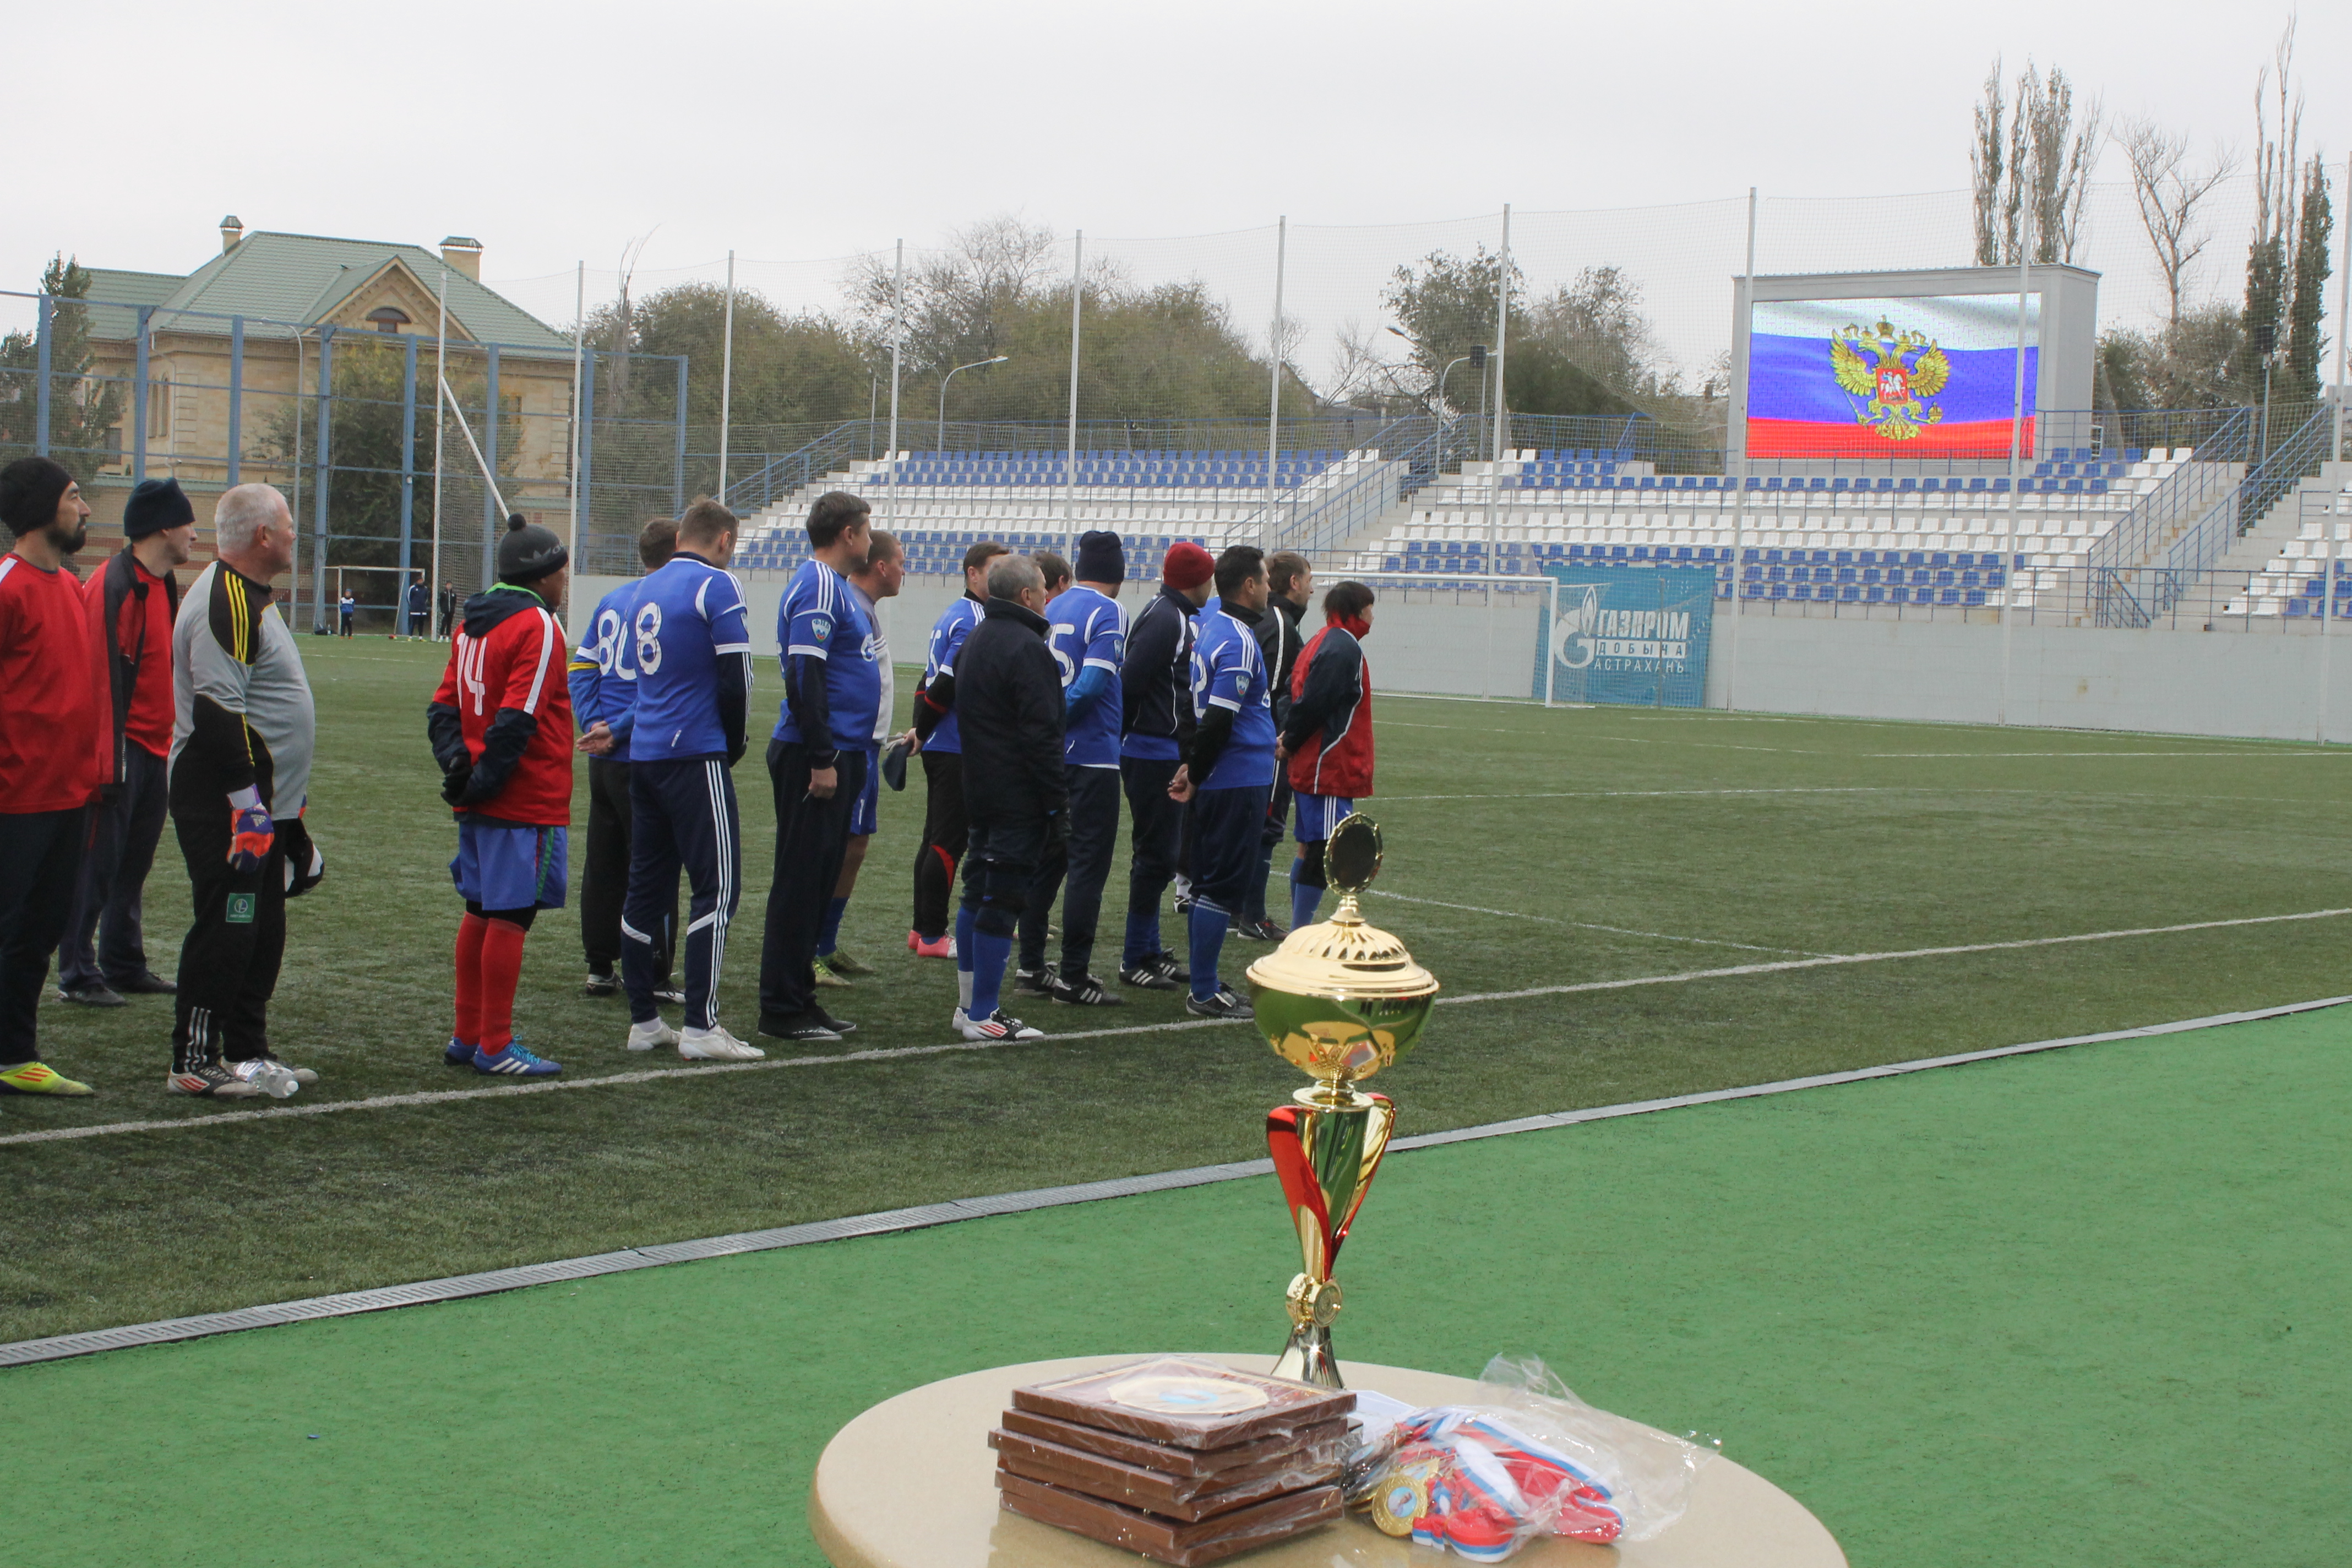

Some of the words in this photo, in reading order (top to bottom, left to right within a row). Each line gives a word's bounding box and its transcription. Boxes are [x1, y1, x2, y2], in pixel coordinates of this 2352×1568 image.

[636, 602, 662, 676] 8
[1597, 609, 1690, 640] ГАЗПРОМ
[1598, 641, 1683, 656] ДОБЫЧА
[456, 633, 486, 716] 14
[1594, 658, 1684, 673] АСТРАХАНЬ
